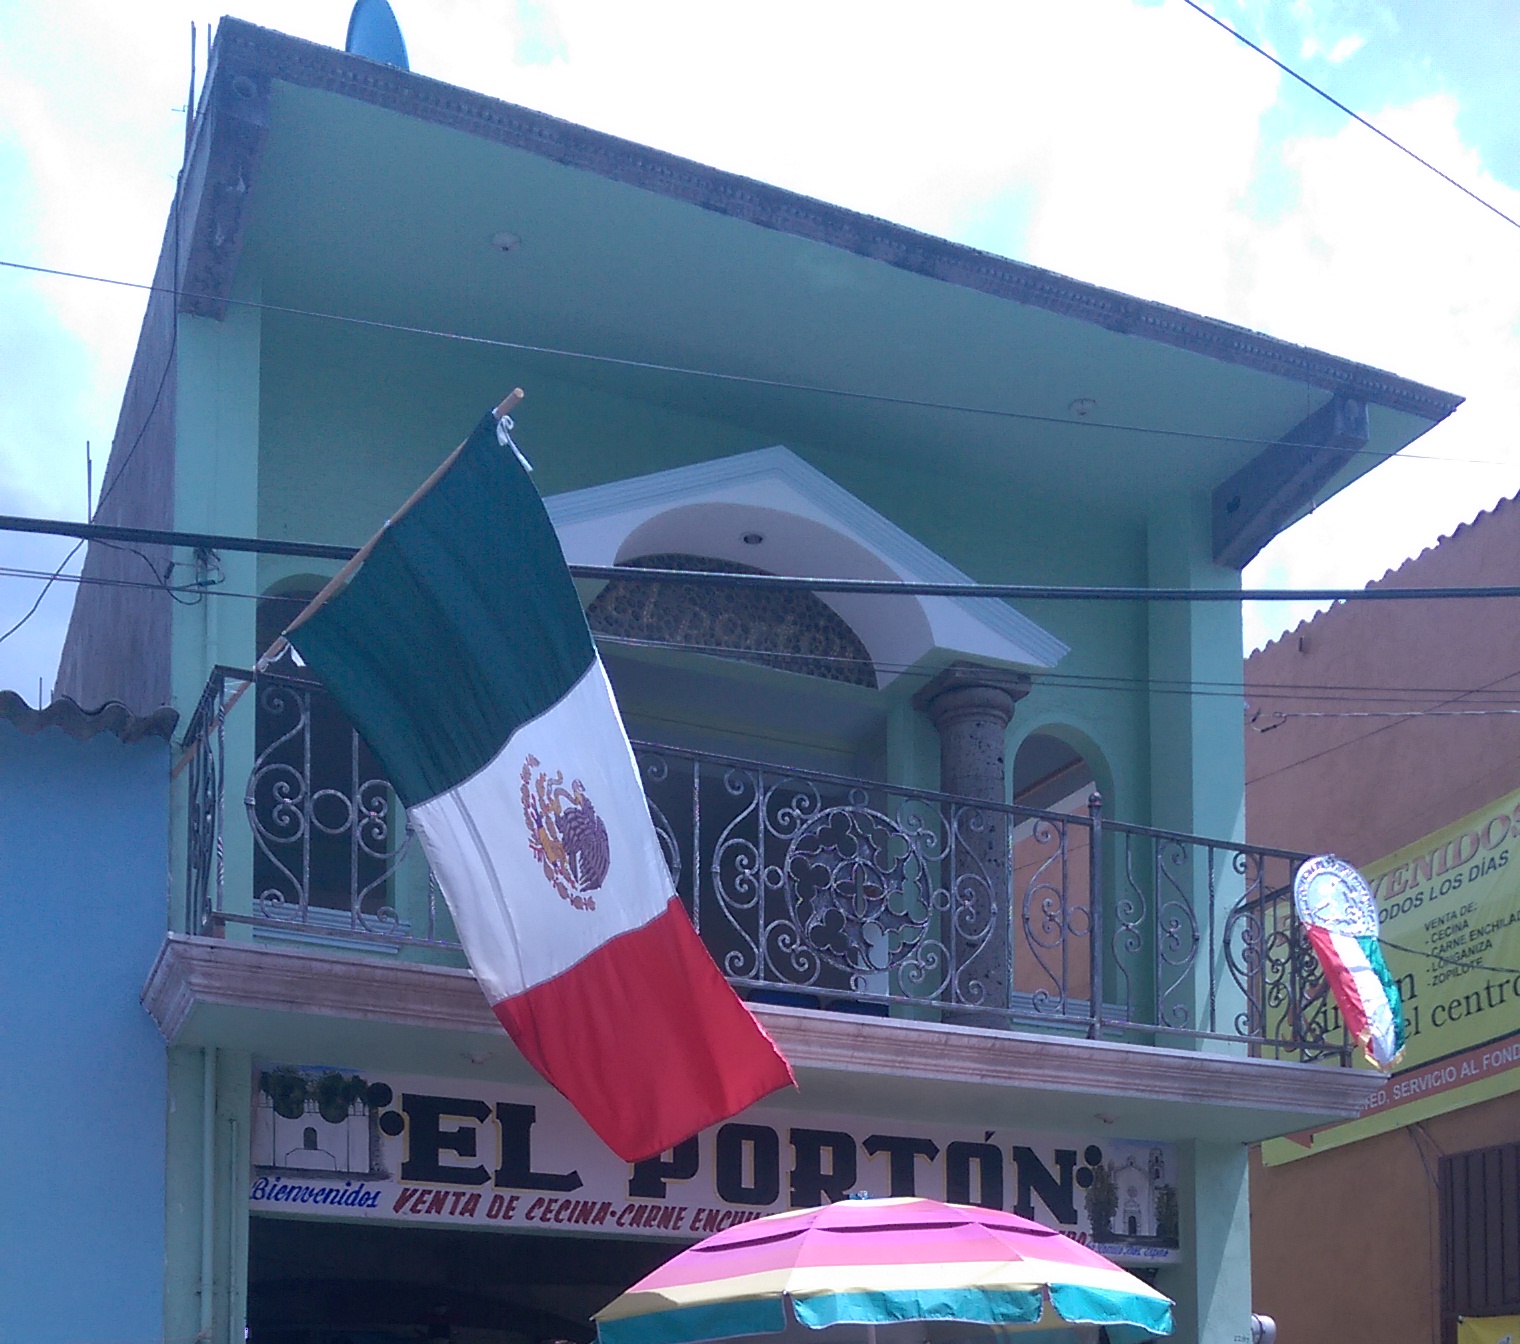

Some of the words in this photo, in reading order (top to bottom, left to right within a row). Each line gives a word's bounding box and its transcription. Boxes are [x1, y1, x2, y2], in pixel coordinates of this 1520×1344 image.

[1380, 892, 1424, 924] ODOS
[1429, 873, 1463, 901] LOS
[1468, 849, 1509, 883] DÍAS
[1424, 911, 1457, 931] VENTA
[1431, 919, 1469, 943] CECINA
[1431, 934, 1467, 956] CARNE
[1432, 940, 1493, 971] LONGANIZA
[1432, 957, 1483, 986] ZOPILOTE
[1403, 1006, 1421, 1040] el
[1364, 1090, 1390, 1110] TED,
[1393, 1067, 1457, 1099] SERVICIO
[1460, 1061, 1480, 1079] AL
[401, 1092, 584, 1192] EL
[628, 1122, 1077, 1225] PORTÓN
[251, 1176, 381, 1208] Bienvenidos
[393, 1187, 482, 1218] VENTA
[486, 1195, 520, 1220] DE
